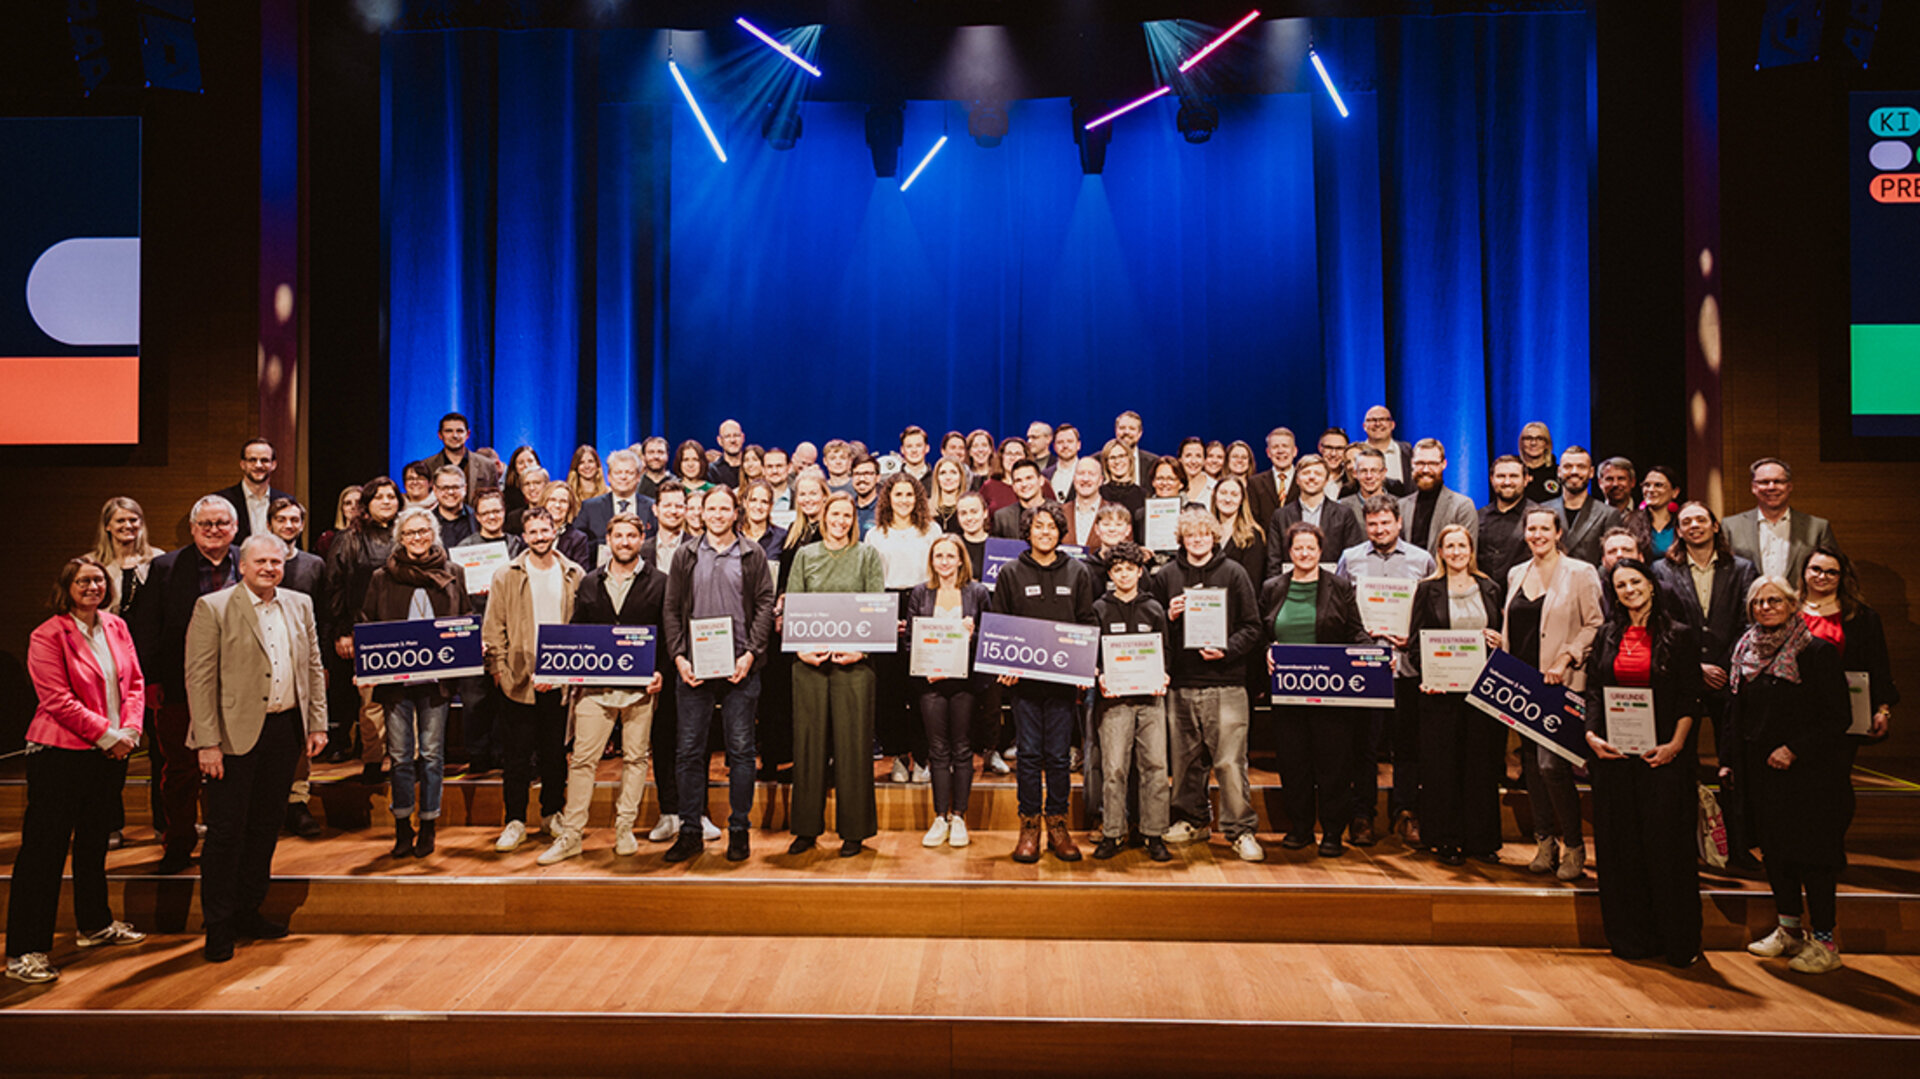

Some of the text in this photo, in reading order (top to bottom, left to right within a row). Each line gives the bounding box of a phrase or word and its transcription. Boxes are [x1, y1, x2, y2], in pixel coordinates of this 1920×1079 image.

[1880, 111, 1910, 132] KI
[787, 620, 872, 638] 10.000 €
[360, 645, 455, 671] 10.000 €
[540, 652, 634, 671] 20.000 €
[982, 641, 1070, 669] 15.000 €
[1276, 672, 1366, 692] 10.000 €
[1479, 676, 1542, 722] 5.000
[1542, 713, 1563, 734] €
